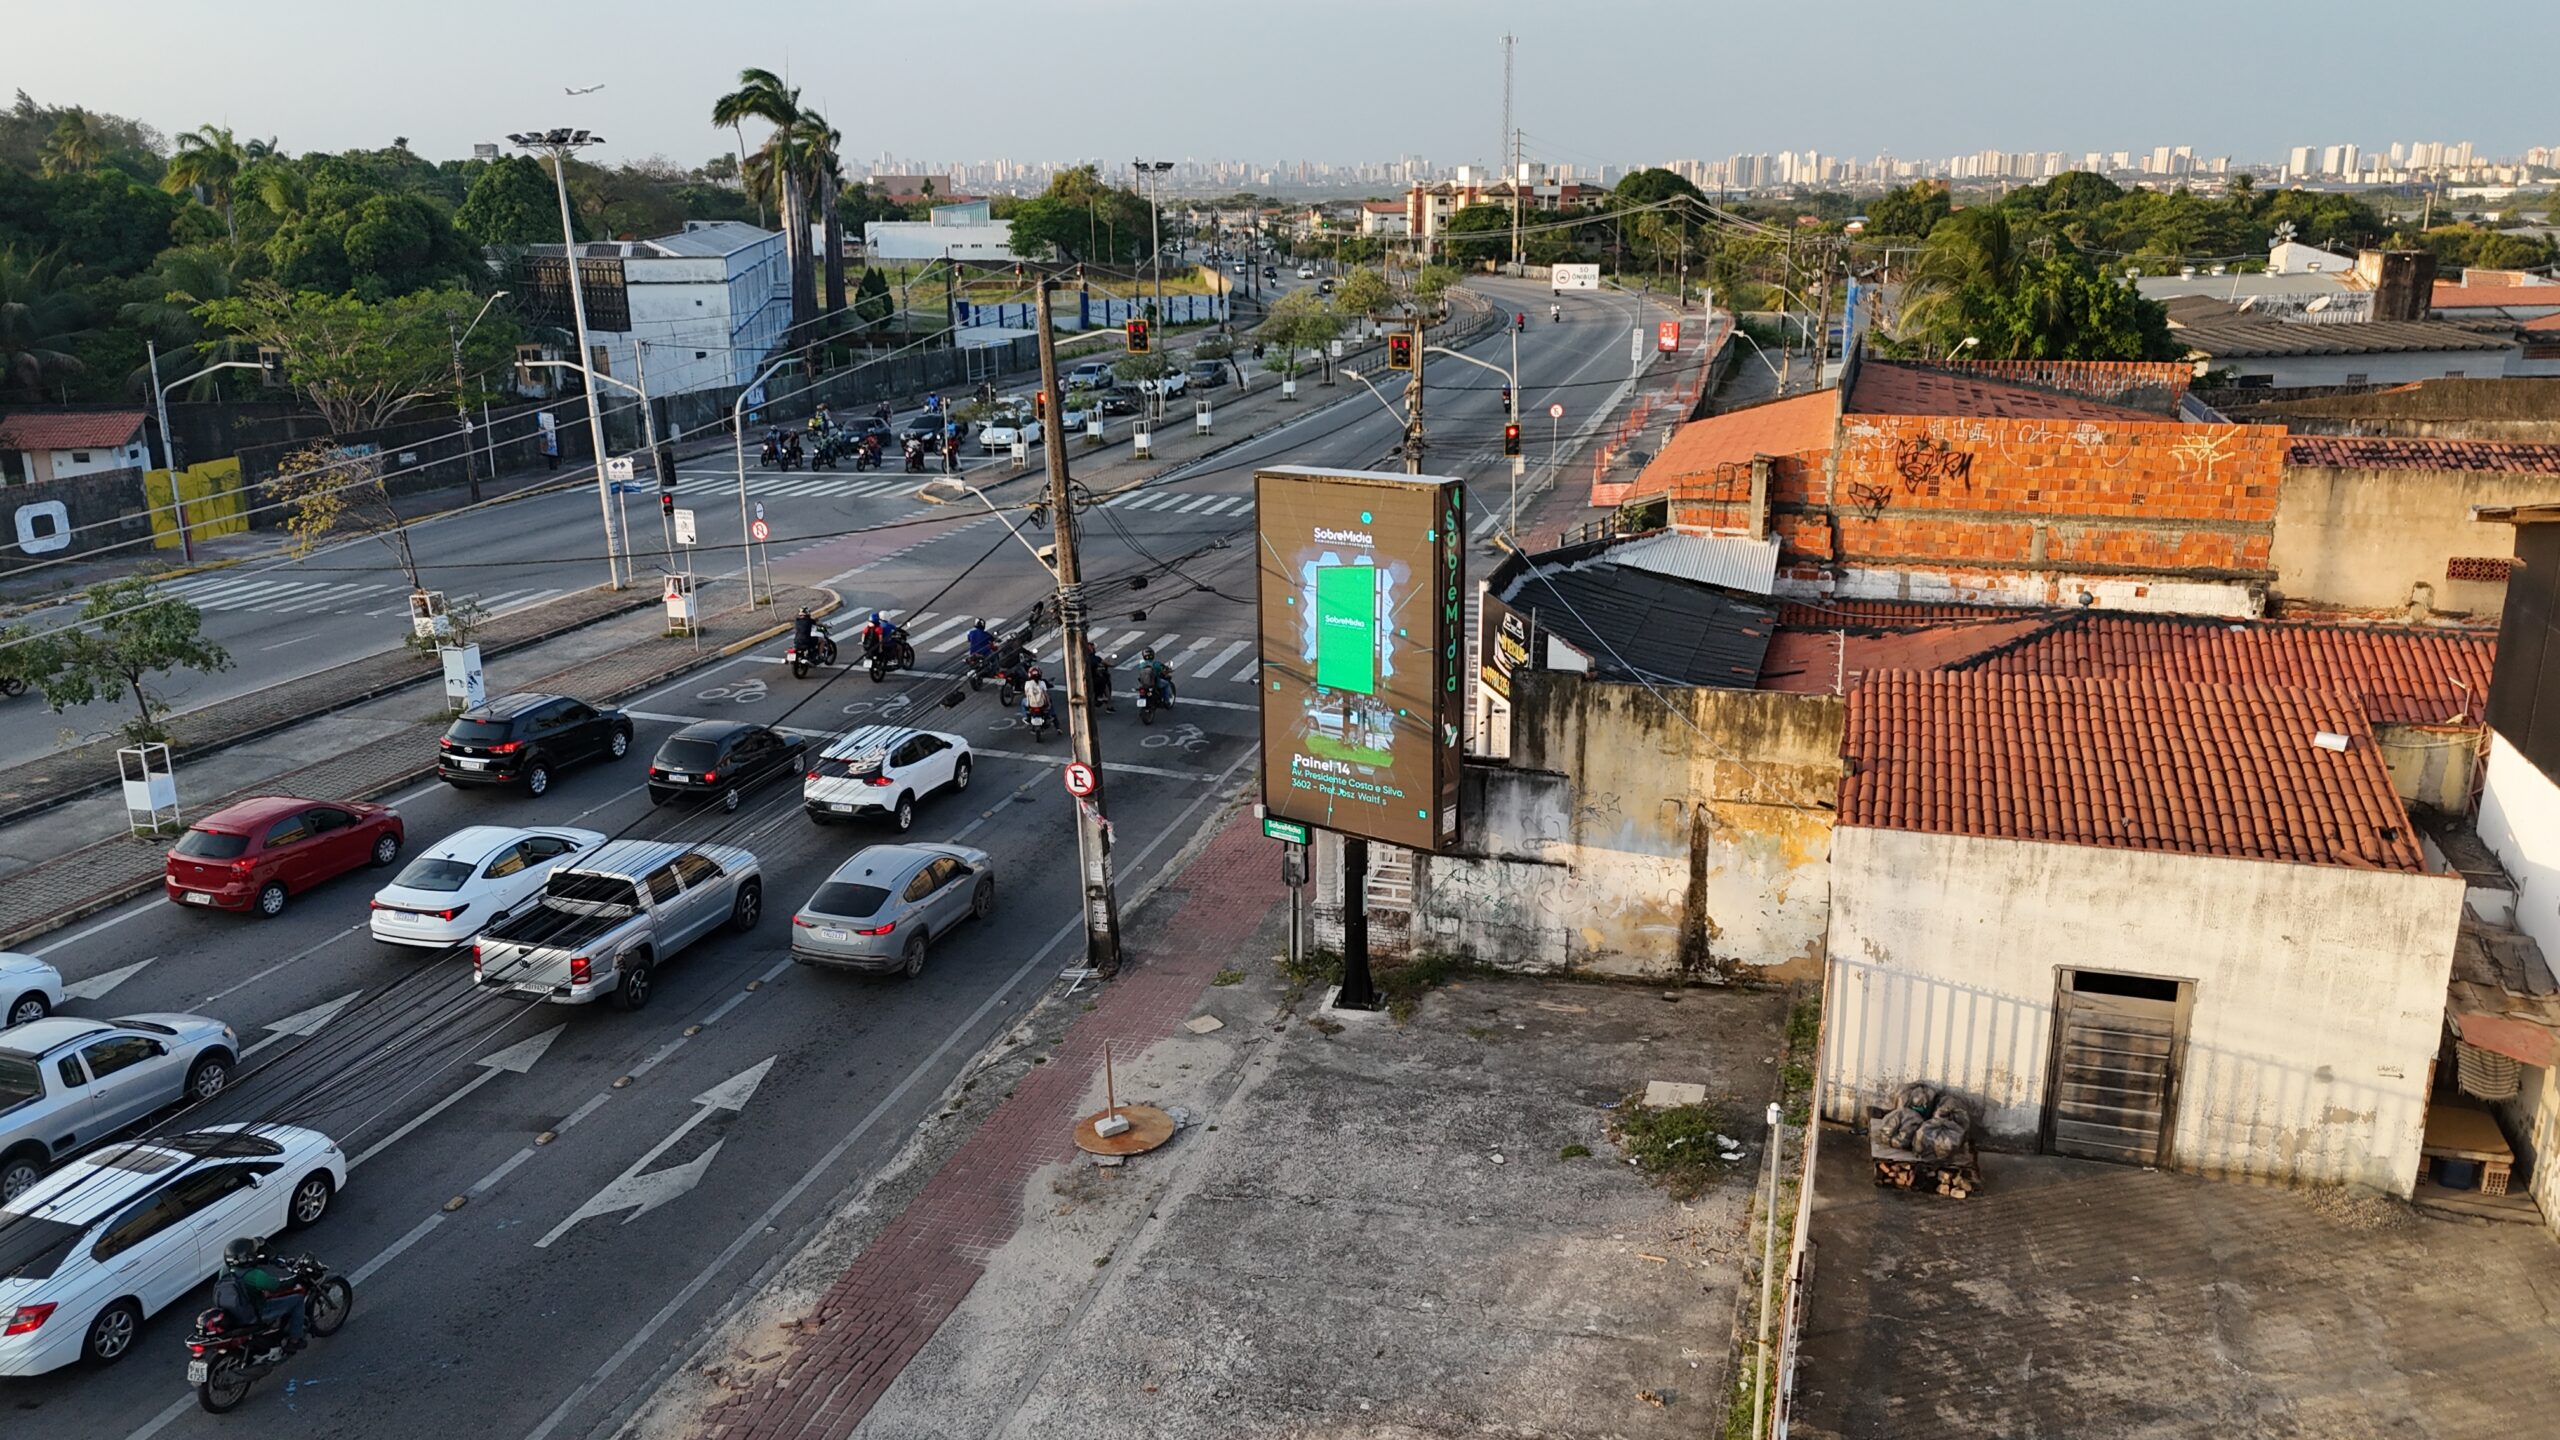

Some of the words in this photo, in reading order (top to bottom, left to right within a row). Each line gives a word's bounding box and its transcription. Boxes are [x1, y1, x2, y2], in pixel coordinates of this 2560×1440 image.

[1294, 753, 1333, 772] Painel
[1336, 763, 1351, 776] 14
[1291, 778, 1312, 790] 3602
[1304, 769, 1347, 786] Presidente
[1348, 778, 1374, 791] Costa
[1375, 785, 1381, 793] e
